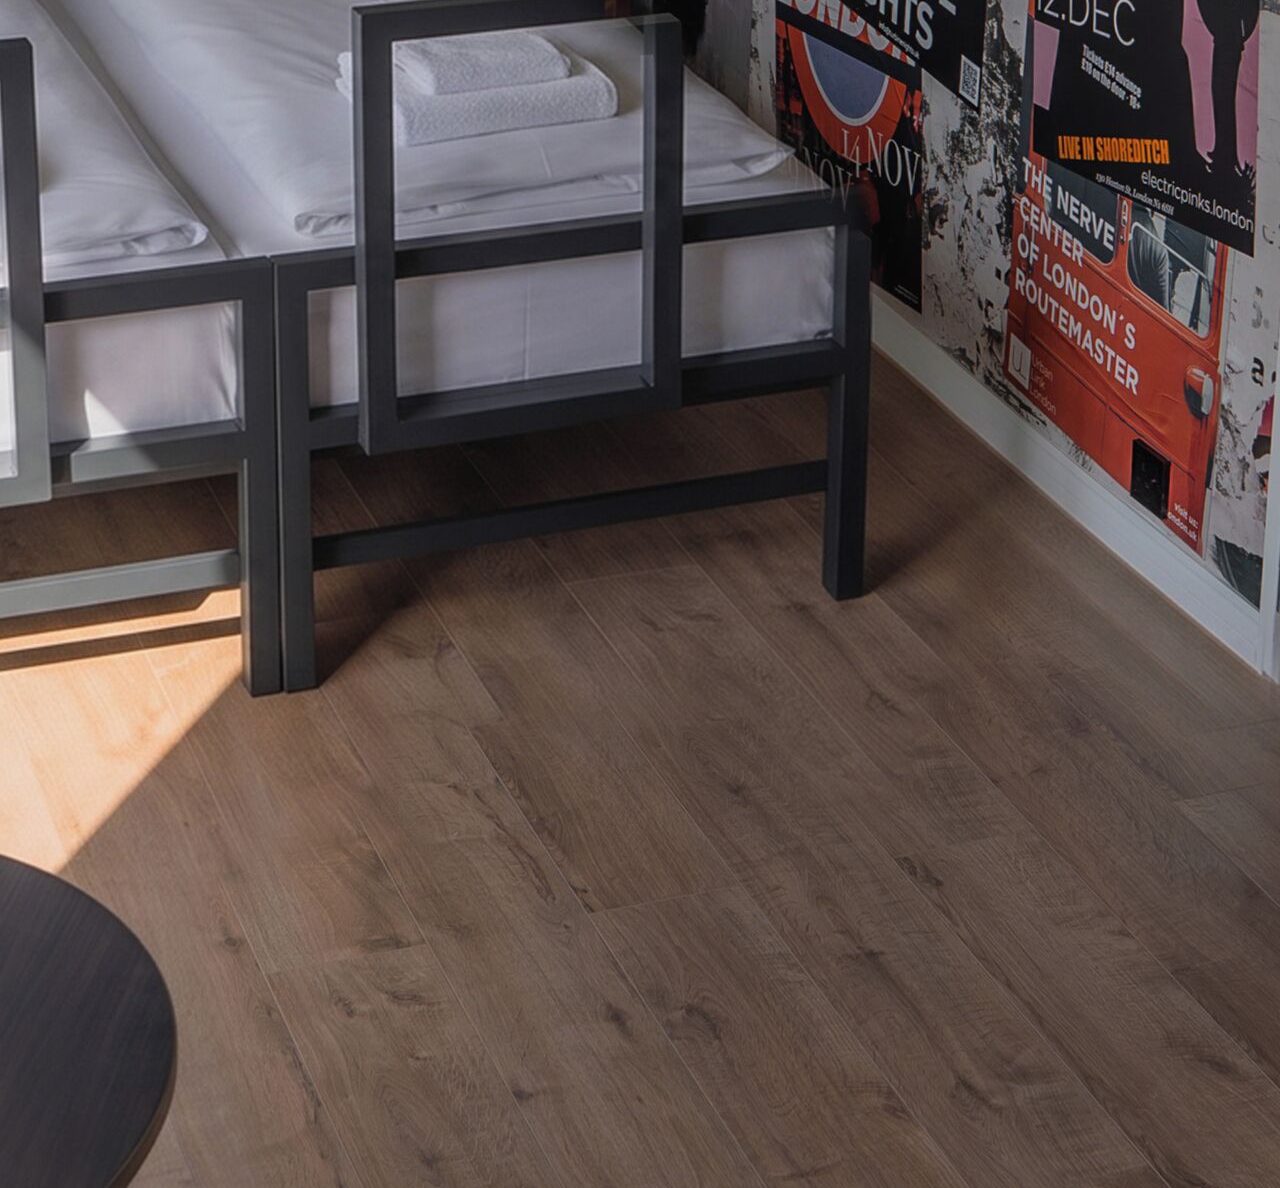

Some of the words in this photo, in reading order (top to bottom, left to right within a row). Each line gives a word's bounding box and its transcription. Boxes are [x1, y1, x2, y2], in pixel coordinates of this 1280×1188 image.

[1082, 43, 1105, 70] Tickets
[1115, 71, 1142, 99] advance
[1092, 67, 1101, 82] on
[1100, 72, 1111, 90] the
[1110, 81, 1127, 101] door
[865, 125, 921, 196] NOV
[1057, 135, 1082, 160] LIVE
[1082, 136, 1095, 162] IN
[1095, 137, 1170, 165] SHOREDITCH
[1022, 156, 1053, 200] THE
[1056, 185, 1116, 253] NERVE
[1132, 188, 1153, 206] London
[1140, 169, 1254, 234] electricpinks.london
[1017, 233, 1040, 264] OF
[1019, 195, 1085, 268] CENTER
[1014, 266, 1140, 396] ROUTEMASTER
[1029, 381, 1057, 417] London
